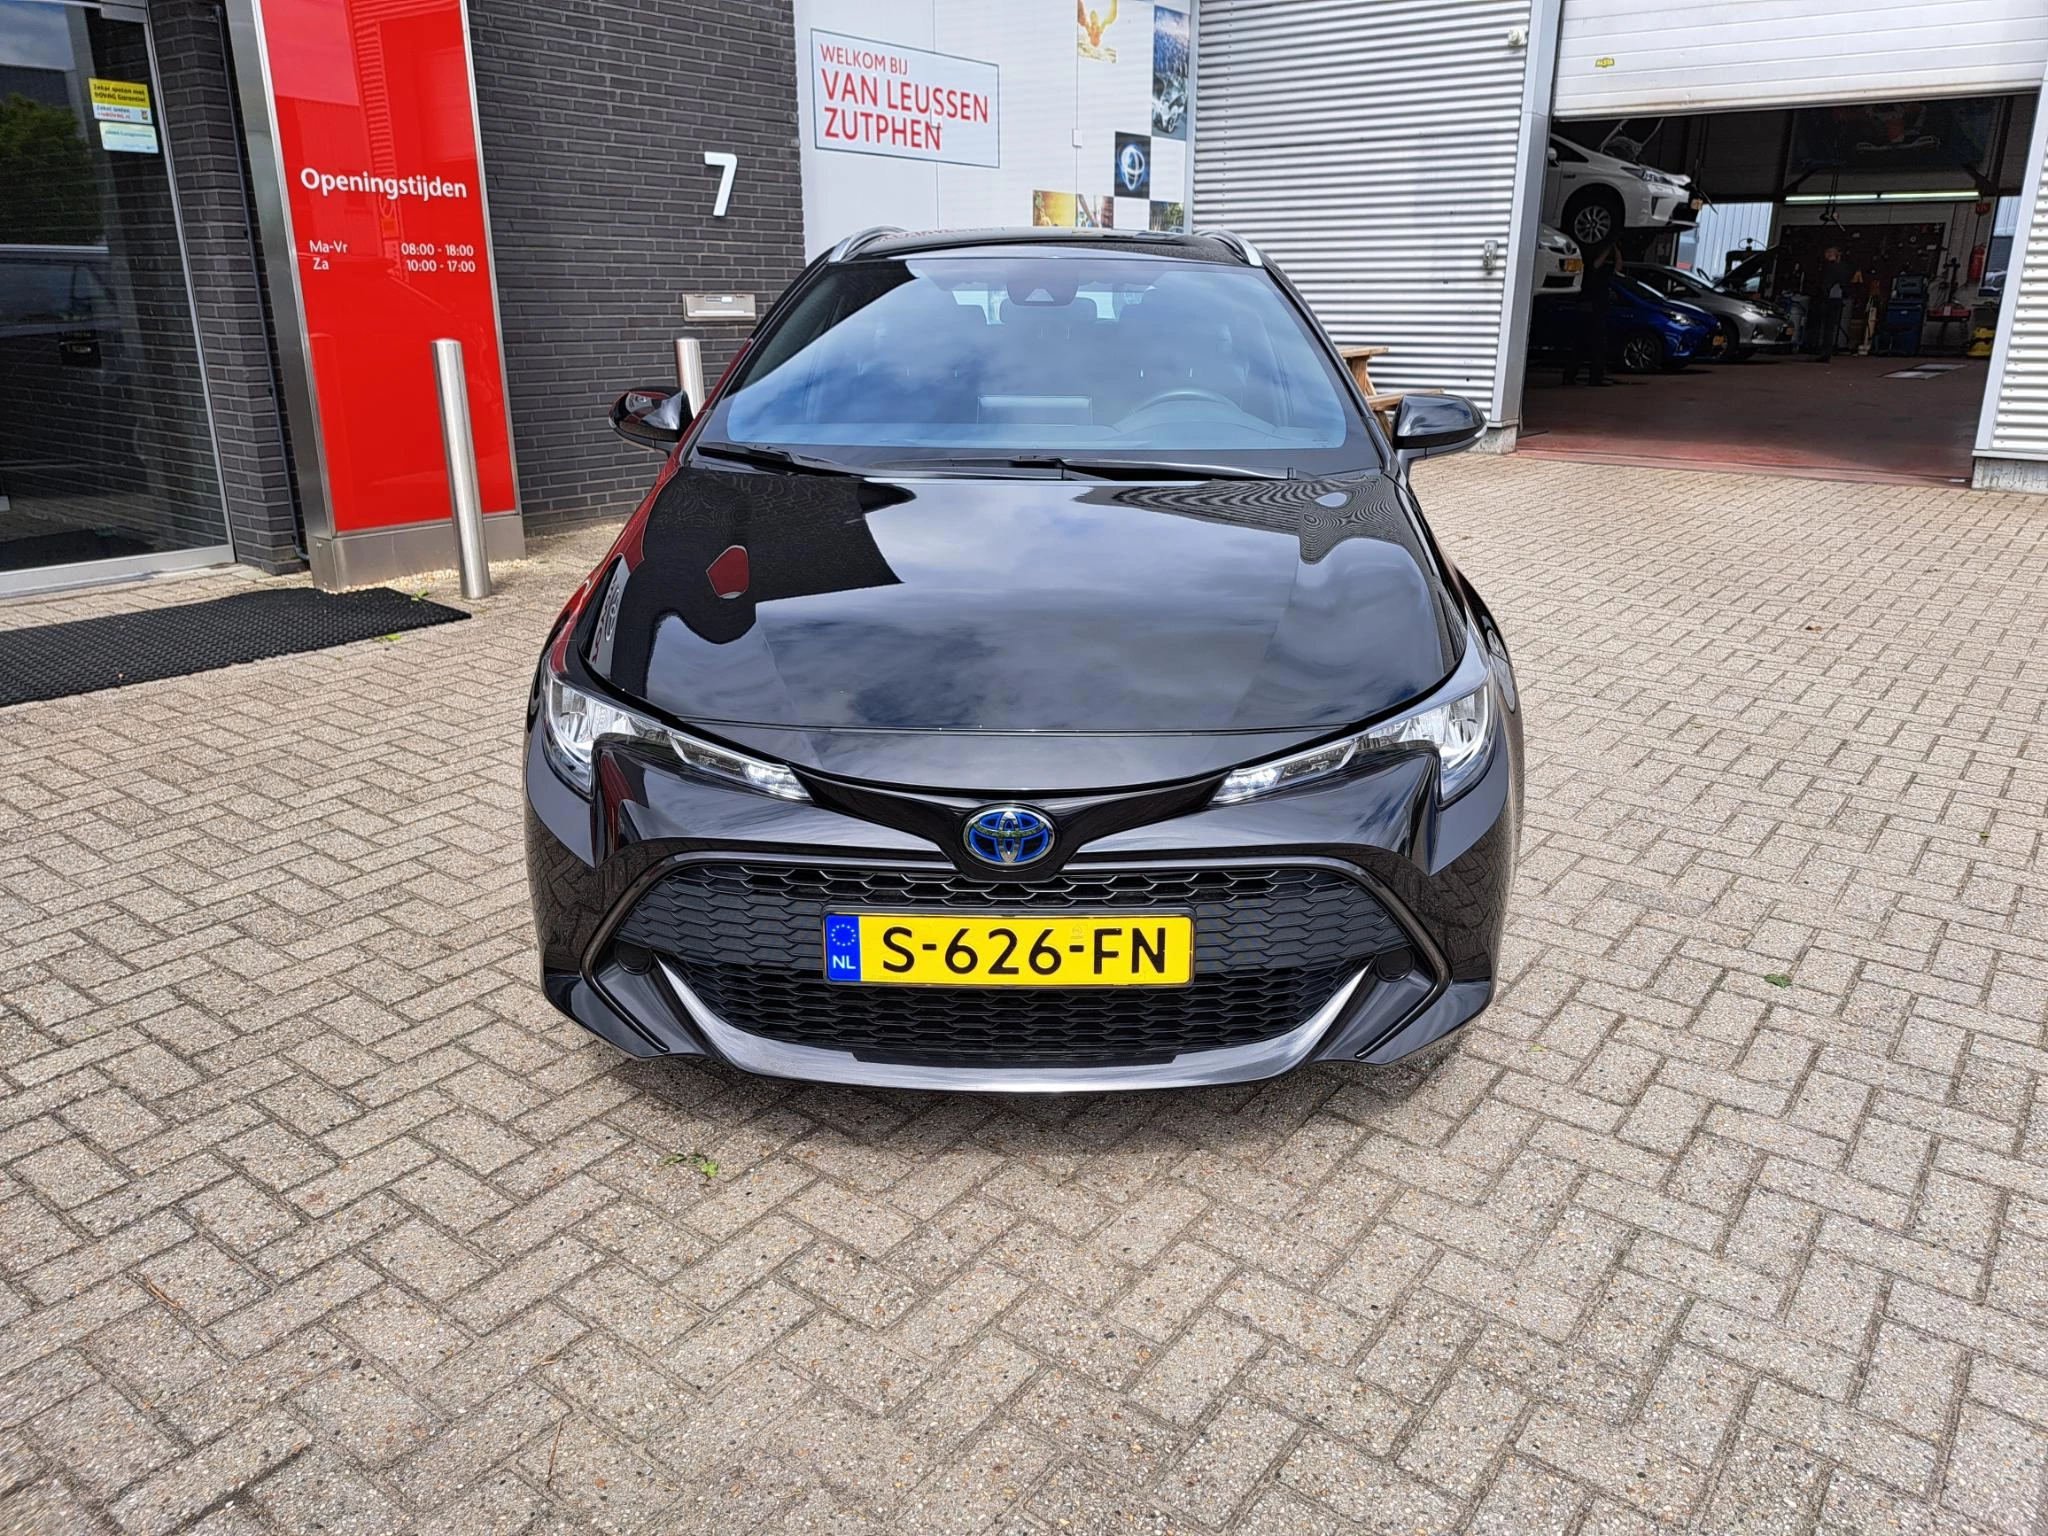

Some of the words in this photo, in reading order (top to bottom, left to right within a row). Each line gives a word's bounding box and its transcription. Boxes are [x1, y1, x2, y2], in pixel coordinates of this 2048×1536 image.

[820, 44, 886, 73] WELKOM
[890, 56, 908, 76] BIJ
[821, 68, 878, 108] VAN
[887, 79, 989, 124] LEUSSEN
[824, 107, 941, 151] ZUTPHEN
[300, 167, 468, 202] Openingstijden
[704, 151, 738, 216] 7
[309, 240, 349, 254] Ma-Vr
[401, 242, 435, 256] 08:00
[445, 244, 475, 257] 18:00
[312, 257, 330, 271] Za
[406, 259, 438, 272] 10:00
[447, 260, 477, 273] 17:00
[832, 955, 857, 970] NL
[882, 926, 1166, 975] S-626-FN
